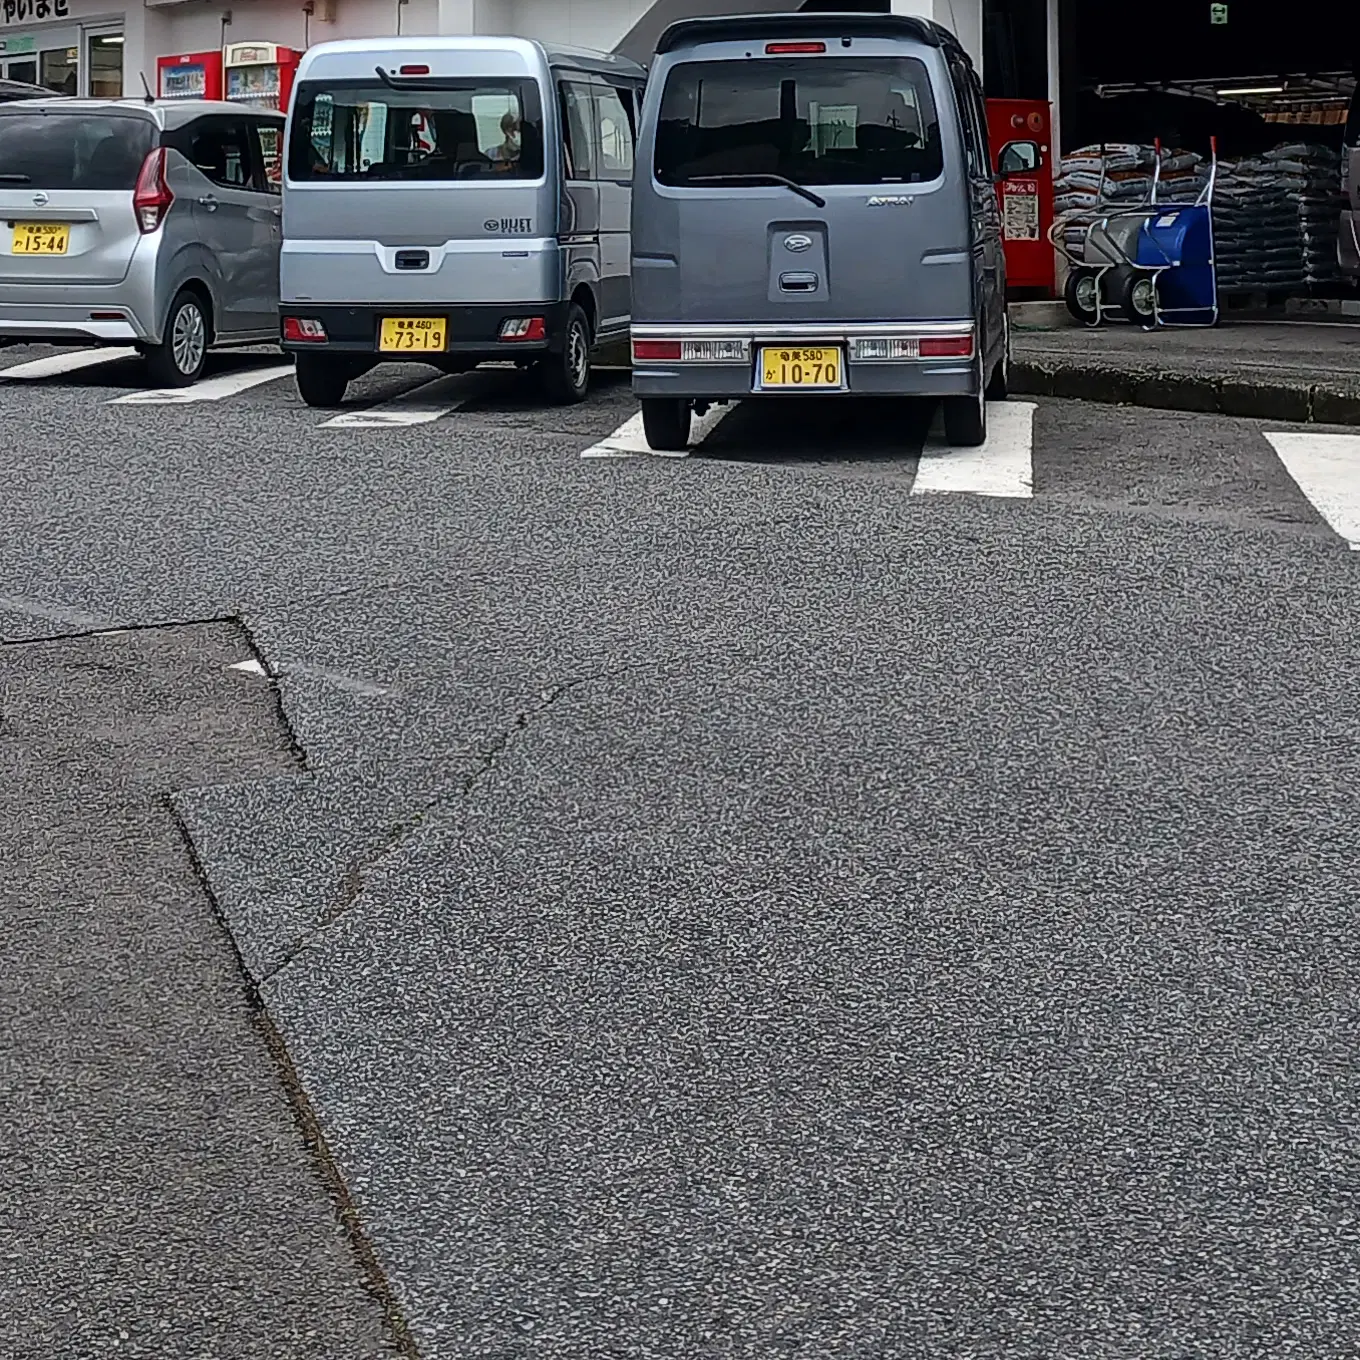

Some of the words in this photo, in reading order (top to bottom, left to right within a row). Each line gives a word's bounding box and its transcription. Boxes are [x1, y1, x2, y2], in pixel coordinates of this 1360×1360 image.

[25, 236, 64, 251] 15-44
[395, 331, 441, 348] 73-19
[782, 364, 836, 384] 10-70
